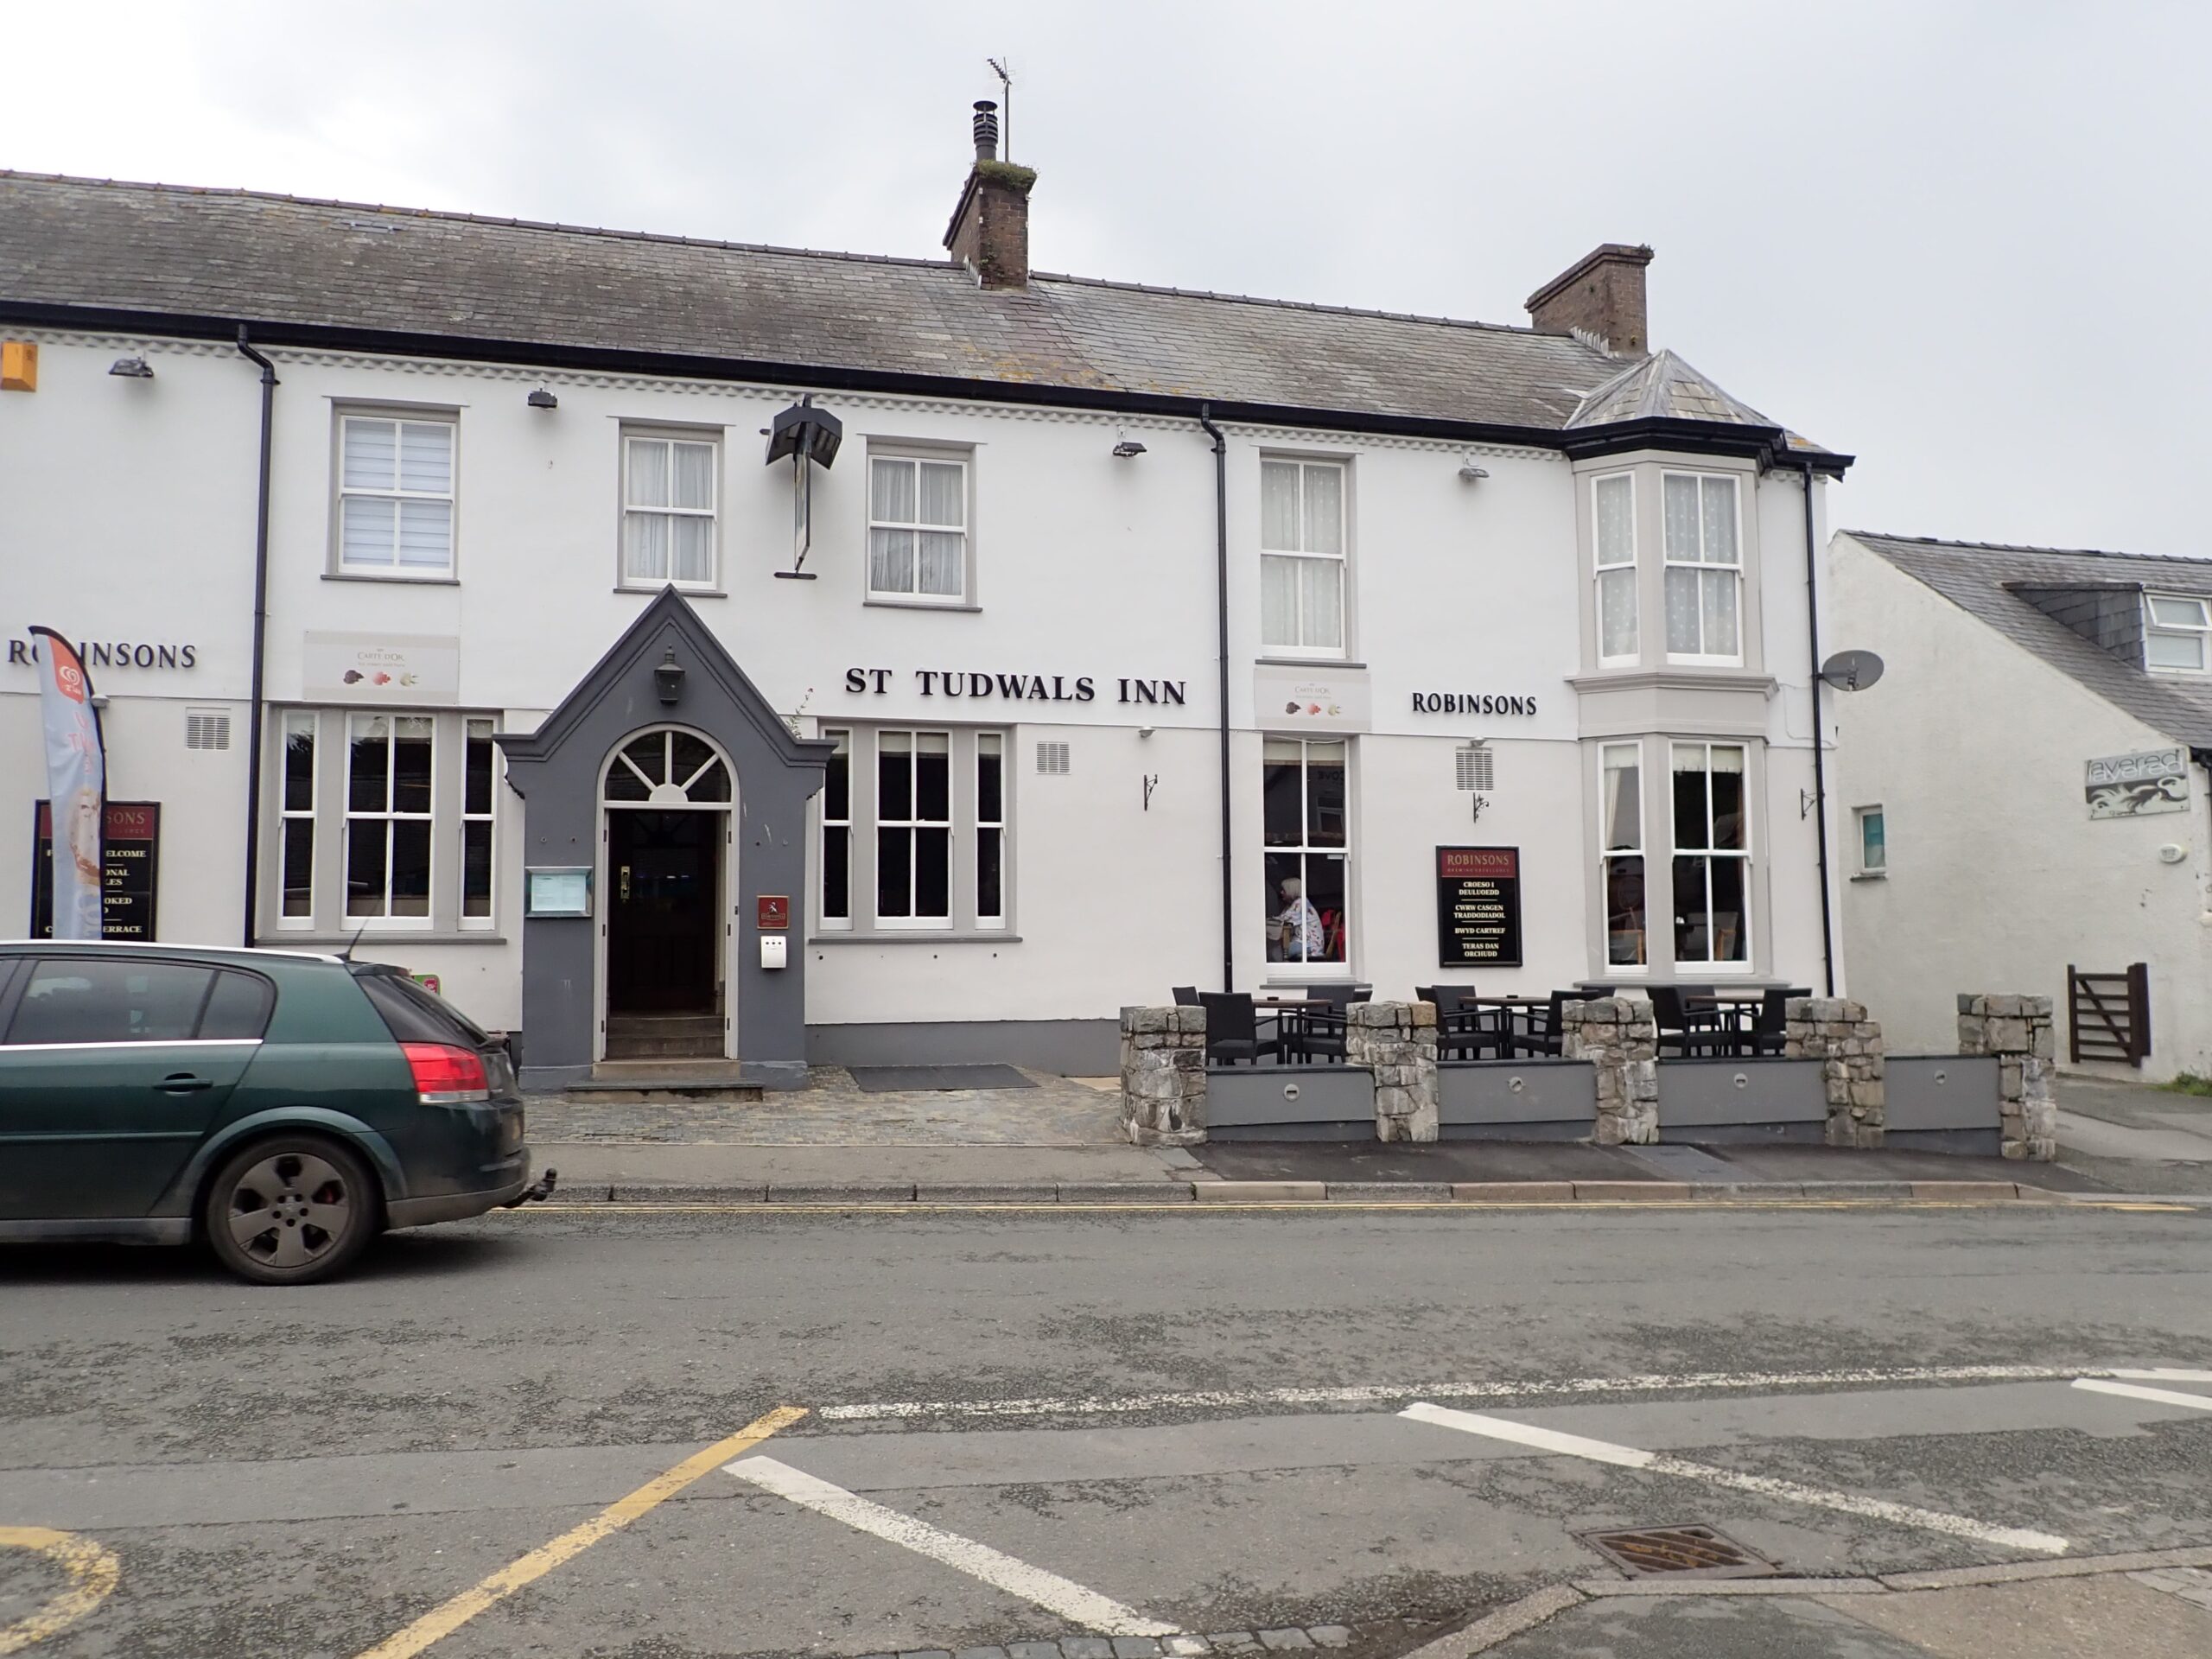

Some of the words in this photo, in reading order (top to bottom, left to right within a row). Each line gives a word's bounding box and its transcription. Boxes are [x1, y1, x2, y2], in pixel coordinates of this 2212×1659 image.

[8, 639, 196, 669] RINSONS
[845, 667, 893, 694] ST
[915, 670, 1096, 702] TUDWALS
[1116, 677, 1186, 705] INN
[1412, 692, 1537, 715] ROBINSONS
[1447, 854, 1510, 866] ROBINSONS
